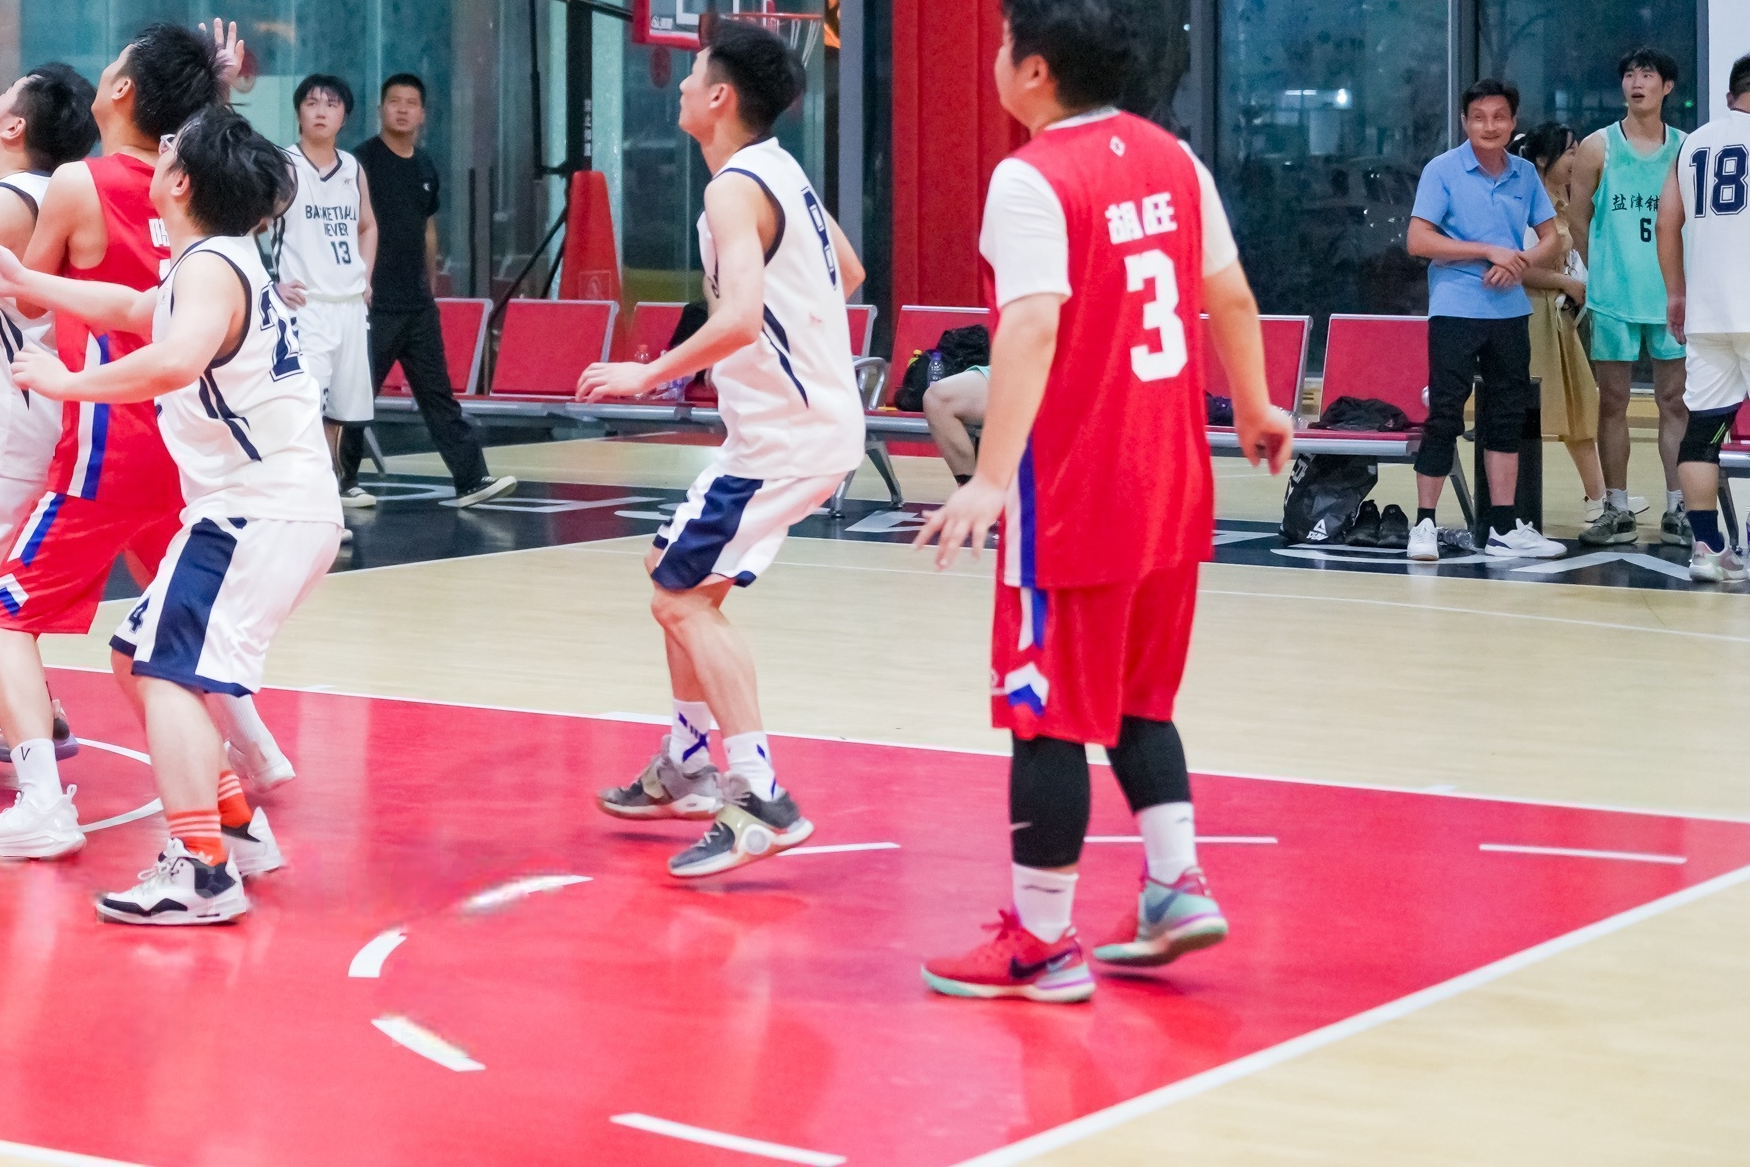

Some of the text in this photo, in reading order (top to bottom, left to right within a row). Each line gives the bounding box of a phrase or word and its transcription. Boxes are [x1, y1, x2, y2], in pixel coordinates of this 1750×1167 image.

[1689, 143, 1749, 219] 18
[305, 205, 357, 221] BAKETBALL
[1640, 217, 1652, 243] 6
[330, 240, 352, 266] 13
[1123, 248, 1188, 382] 3
[127, 594, 151, 635] 4
